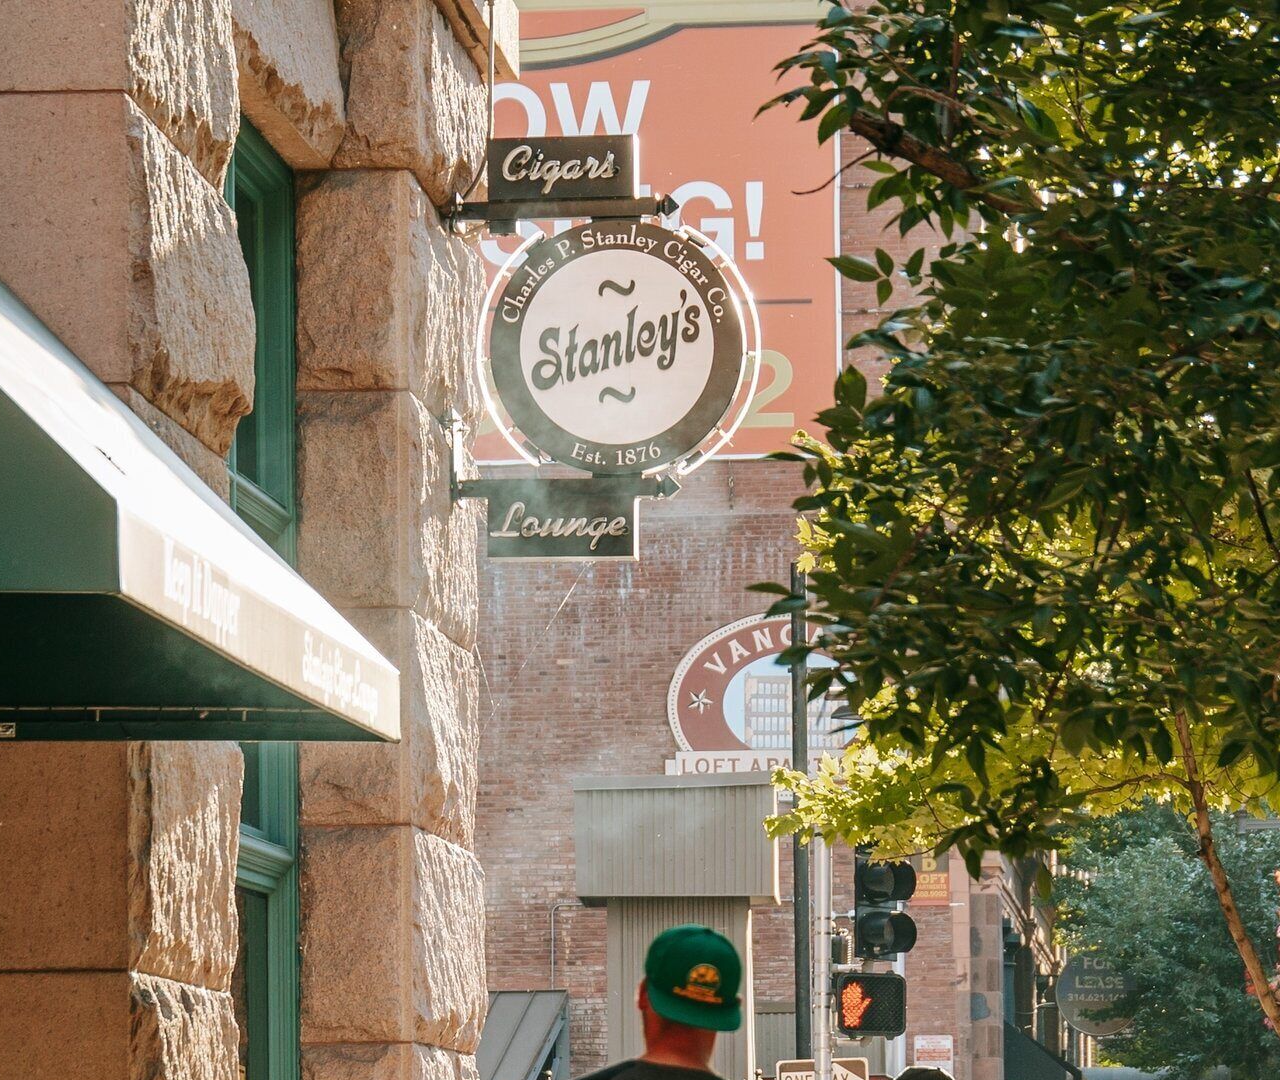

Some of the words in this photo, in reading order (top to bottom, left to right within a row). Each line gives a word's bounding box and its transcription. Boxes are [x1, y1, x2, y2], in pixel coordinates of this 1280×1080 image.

[502, 145, 617, 194] Cigars
[502, 258, 555, 324] Charles
[554, 239, 575, 260] P.
[581, 225, 658, 253] Stanley
[663, 240, 709, 288] Cigar
[707, 287, 729, 324] Co.
[531, 288, 701, 391] Stanley's
[570, 443, 608, 466] Est.
[615, 443, 662, 466] 1876
[490, 501, 629, 550] Lounge
[681, 757, 741, 775] LOFT
[916, 873, 948, 884] OFT
[1075, 975, 1125, 989] LEASE
